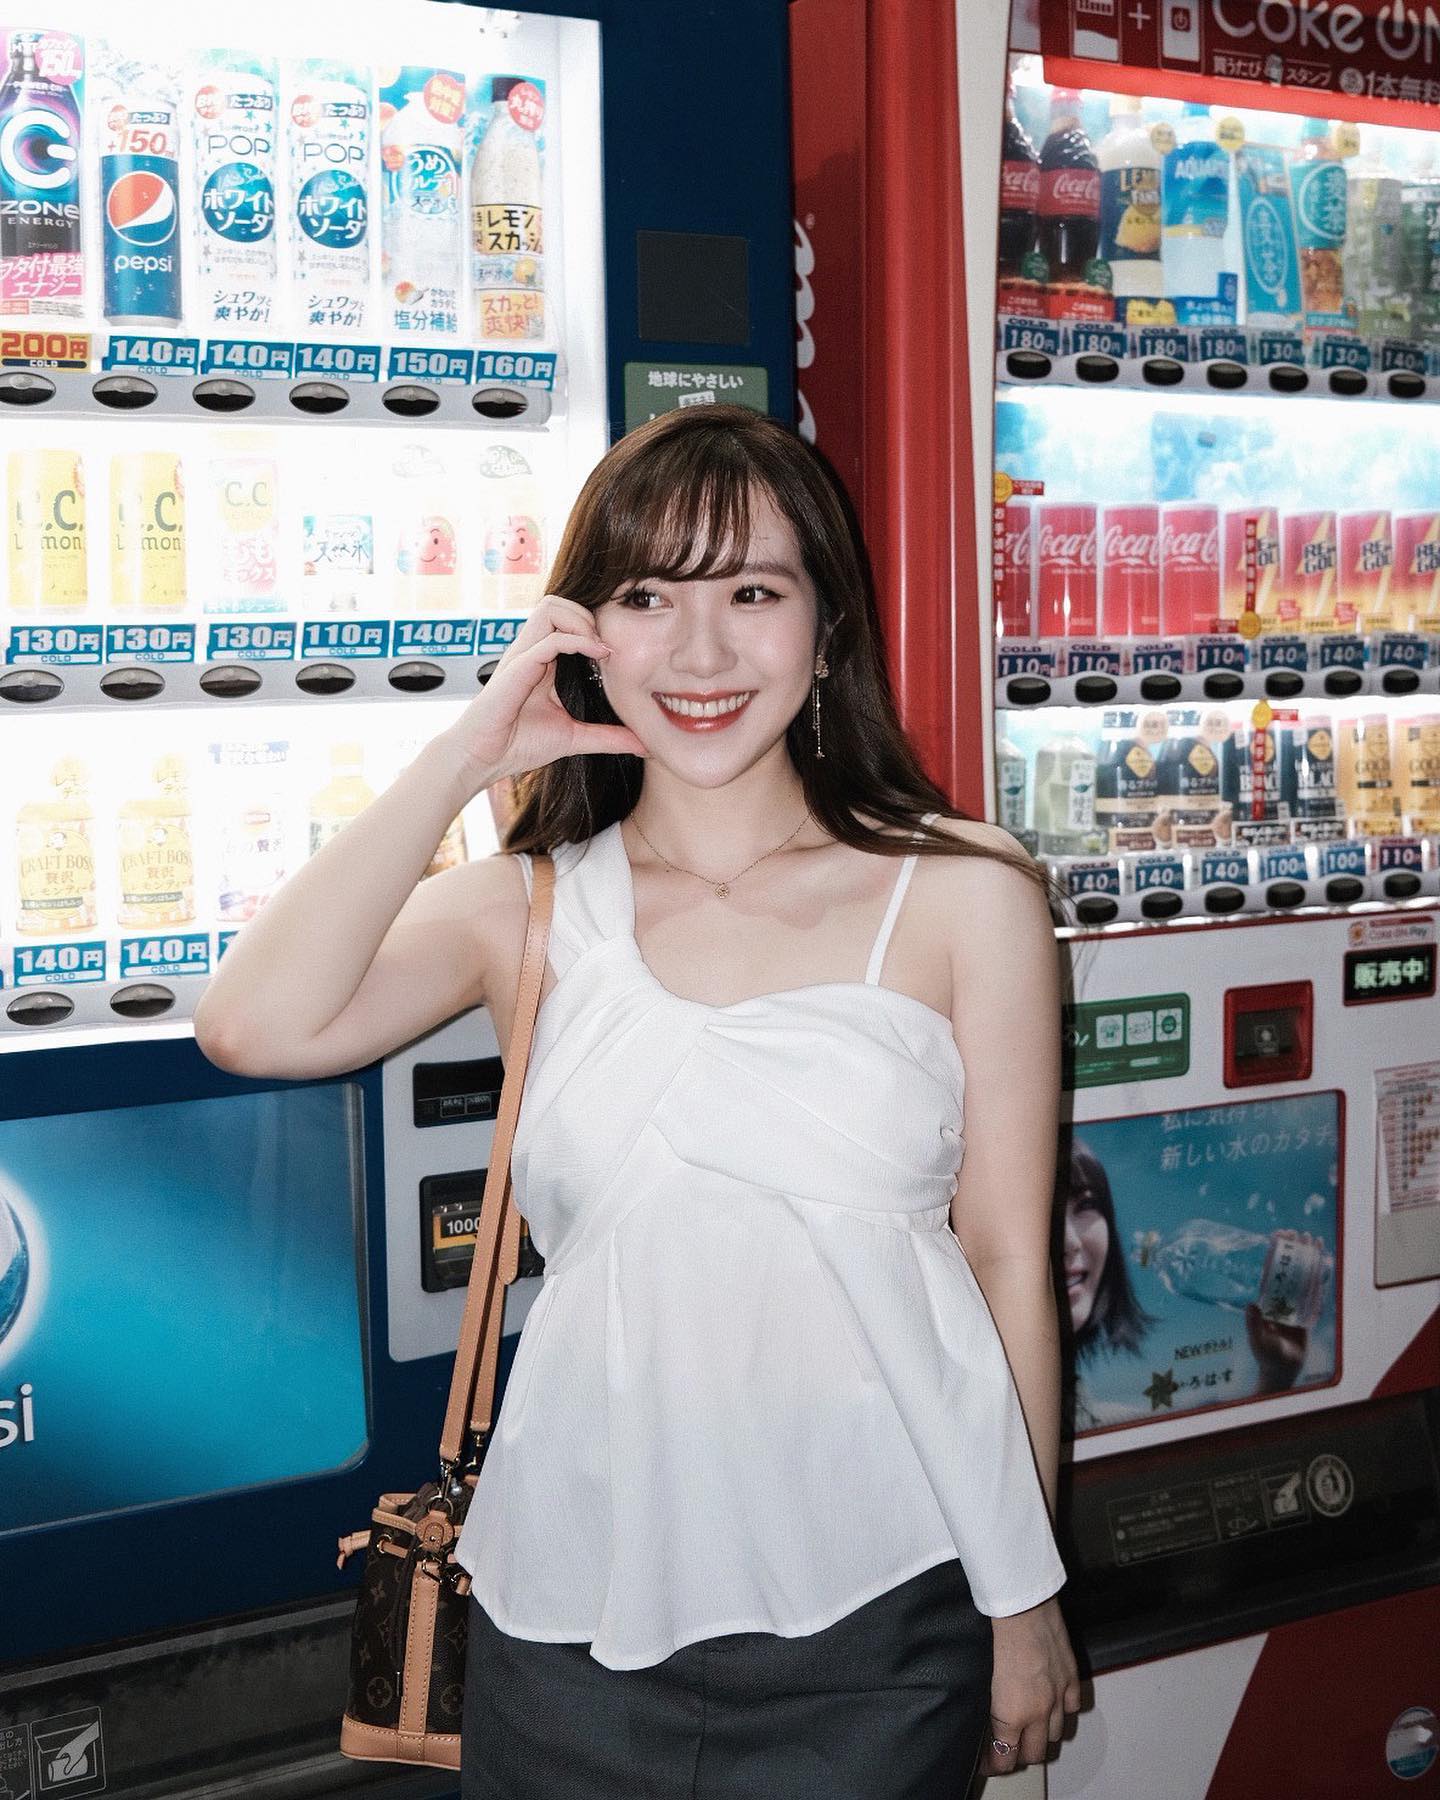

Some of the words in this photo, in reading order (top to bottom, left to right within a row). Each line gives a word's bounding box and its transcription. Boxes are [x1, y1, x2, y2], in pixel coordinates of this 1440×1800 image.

[1211, 0, 1364, 53] Coke
[1213, 56, 1261, 77] 買うたび
[208, 135, 271, 156] POP
[303, 142, 365, 163] POP
[204, 188, 274, 213] ホワイト
[300, 195, 366, 220] ホワイト
[8, 217, 74, 228] ENERGY
[214, 210, 273, 233] ソーダ
[309, 217, 366, 239] ソーダ
[487, 209, 534, 229] レモン
[114, 255, 172, 274] pepsi
[394, 310, 458, 332] 塩分補給
[1, 333, 88, 359] 200円
[111, 340, 195, 364] 140円
[210, 343, 290, 368] 140円
[30, 360, 58, 368] COLD
[300, 348, 375, 371] 140円
[394, 353, 467, 375] 150円
[482, 355, 552, 379] 160円
[648, 371, 744, 389] 地球にやさしい
[14, 630, 100, 652] 130円
[110, 628, 192, 650] 130円
[214, 626, 292, 648] 130円
[306, 624, 383, 645] 110円
[400, 623, 473, 643] 140円
[136, 653, 165, 661] COLD
[238, 650, 266, 658] COLD
[329, 647, 357, 655] COLD
[420, 646, 448, 654] COLD
[1071, 644, 1111, 652] COLD
[1135, 643, 1174, 652] COLD
[17, 946, 102, 972] 140円
[123, 939, 208, 964] 140円
[45, 972, 76, 982] COLD
[151, 965, 180, 973] COLD
[1354, 956, 1424, 989] 販売中
